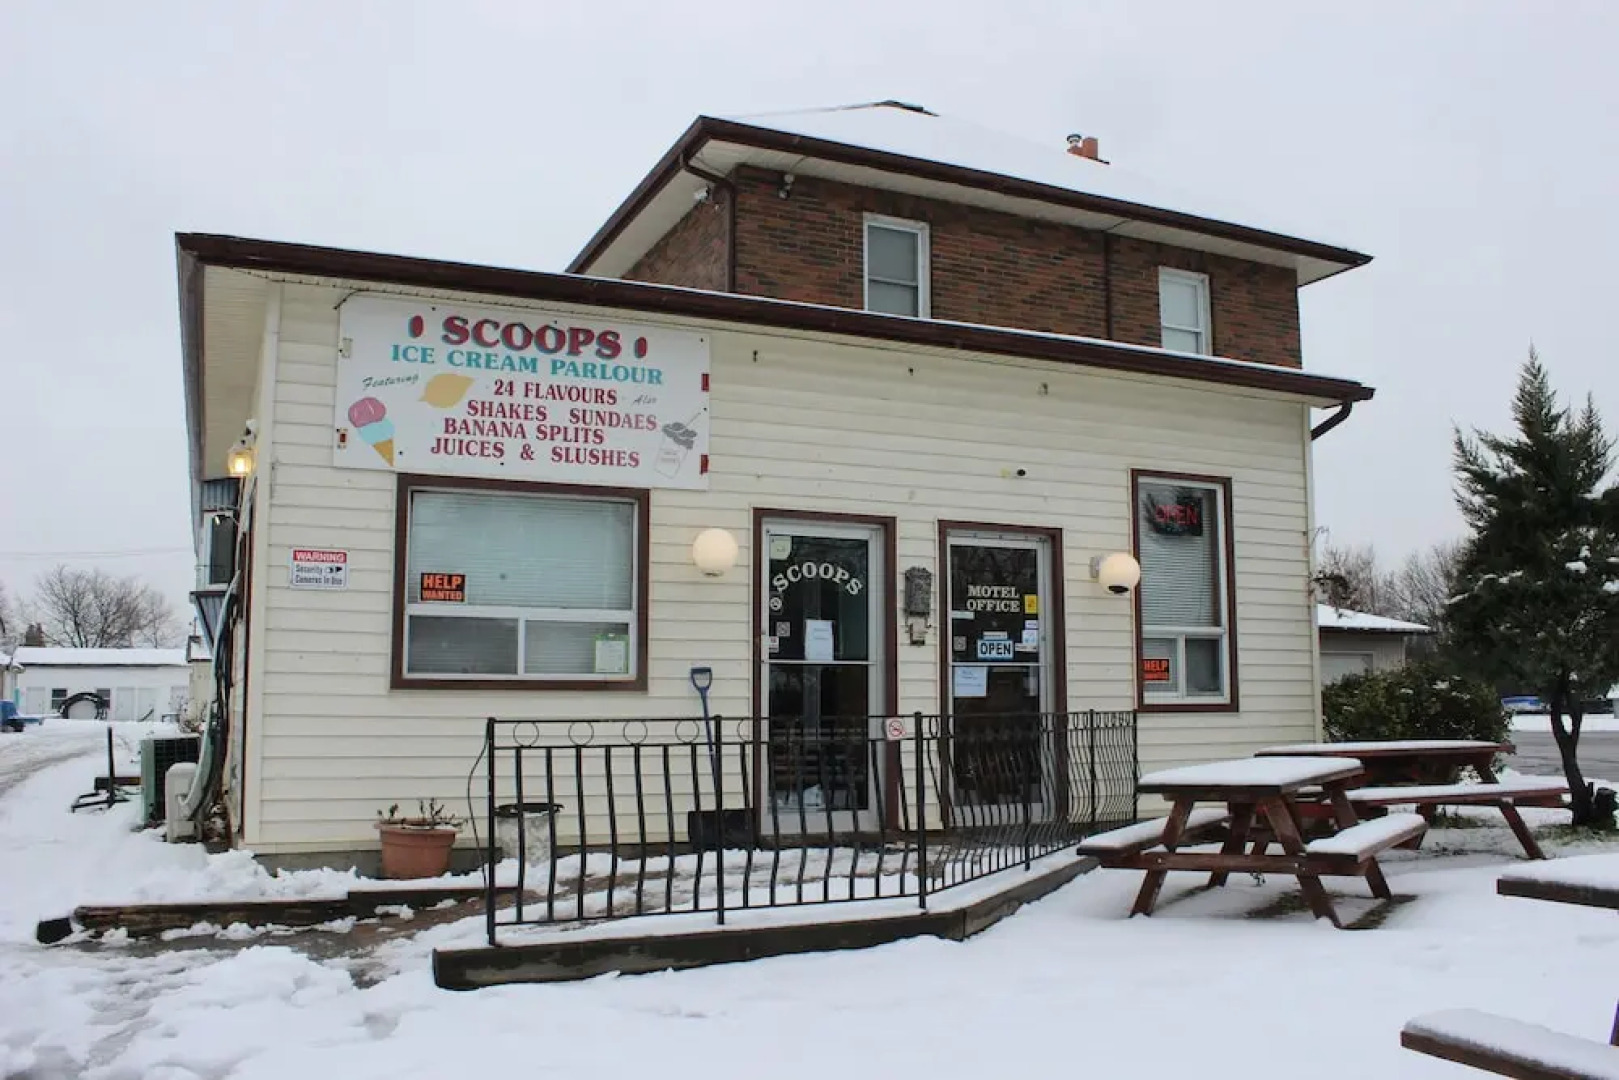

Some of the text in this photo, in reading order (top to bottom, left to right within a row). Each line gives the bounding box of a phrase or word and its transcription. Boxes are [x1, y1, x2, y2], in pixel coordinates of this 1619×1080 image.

[441, 315, 622, 359] SCOOPS
[391, 344, 663, 385] ICE CREAM PARLOUR
[362, 373, 419, 391] Featuring
[494, 378, 617, 406] 24 FLAVOURS
[466, 399, 657, 431] SHAKES SUNDAES
[443, 417, 605, 445] BANANA SPLITS
[430, 437, 505, 458] JUICES
[520, 443, 535, 461] &
[551, 446, 641, 468] SLUSHES
[295, 551, 345, 562] WARNING
[295, 564, 323, 574] Security
[295, 574, 322, 584] Cameras
[423, 574, 463, 588] HELP
[772, 561, 863, 595] SCOOPS
[422, 590, 463, 600] WANTED
[966, 584, 1020, 598] MOTEL
[966, 598, 1021, 613] OFFICE
[980, 642, 1012, 655] OPEN
[1143, 660, 1168, 671] HELP
